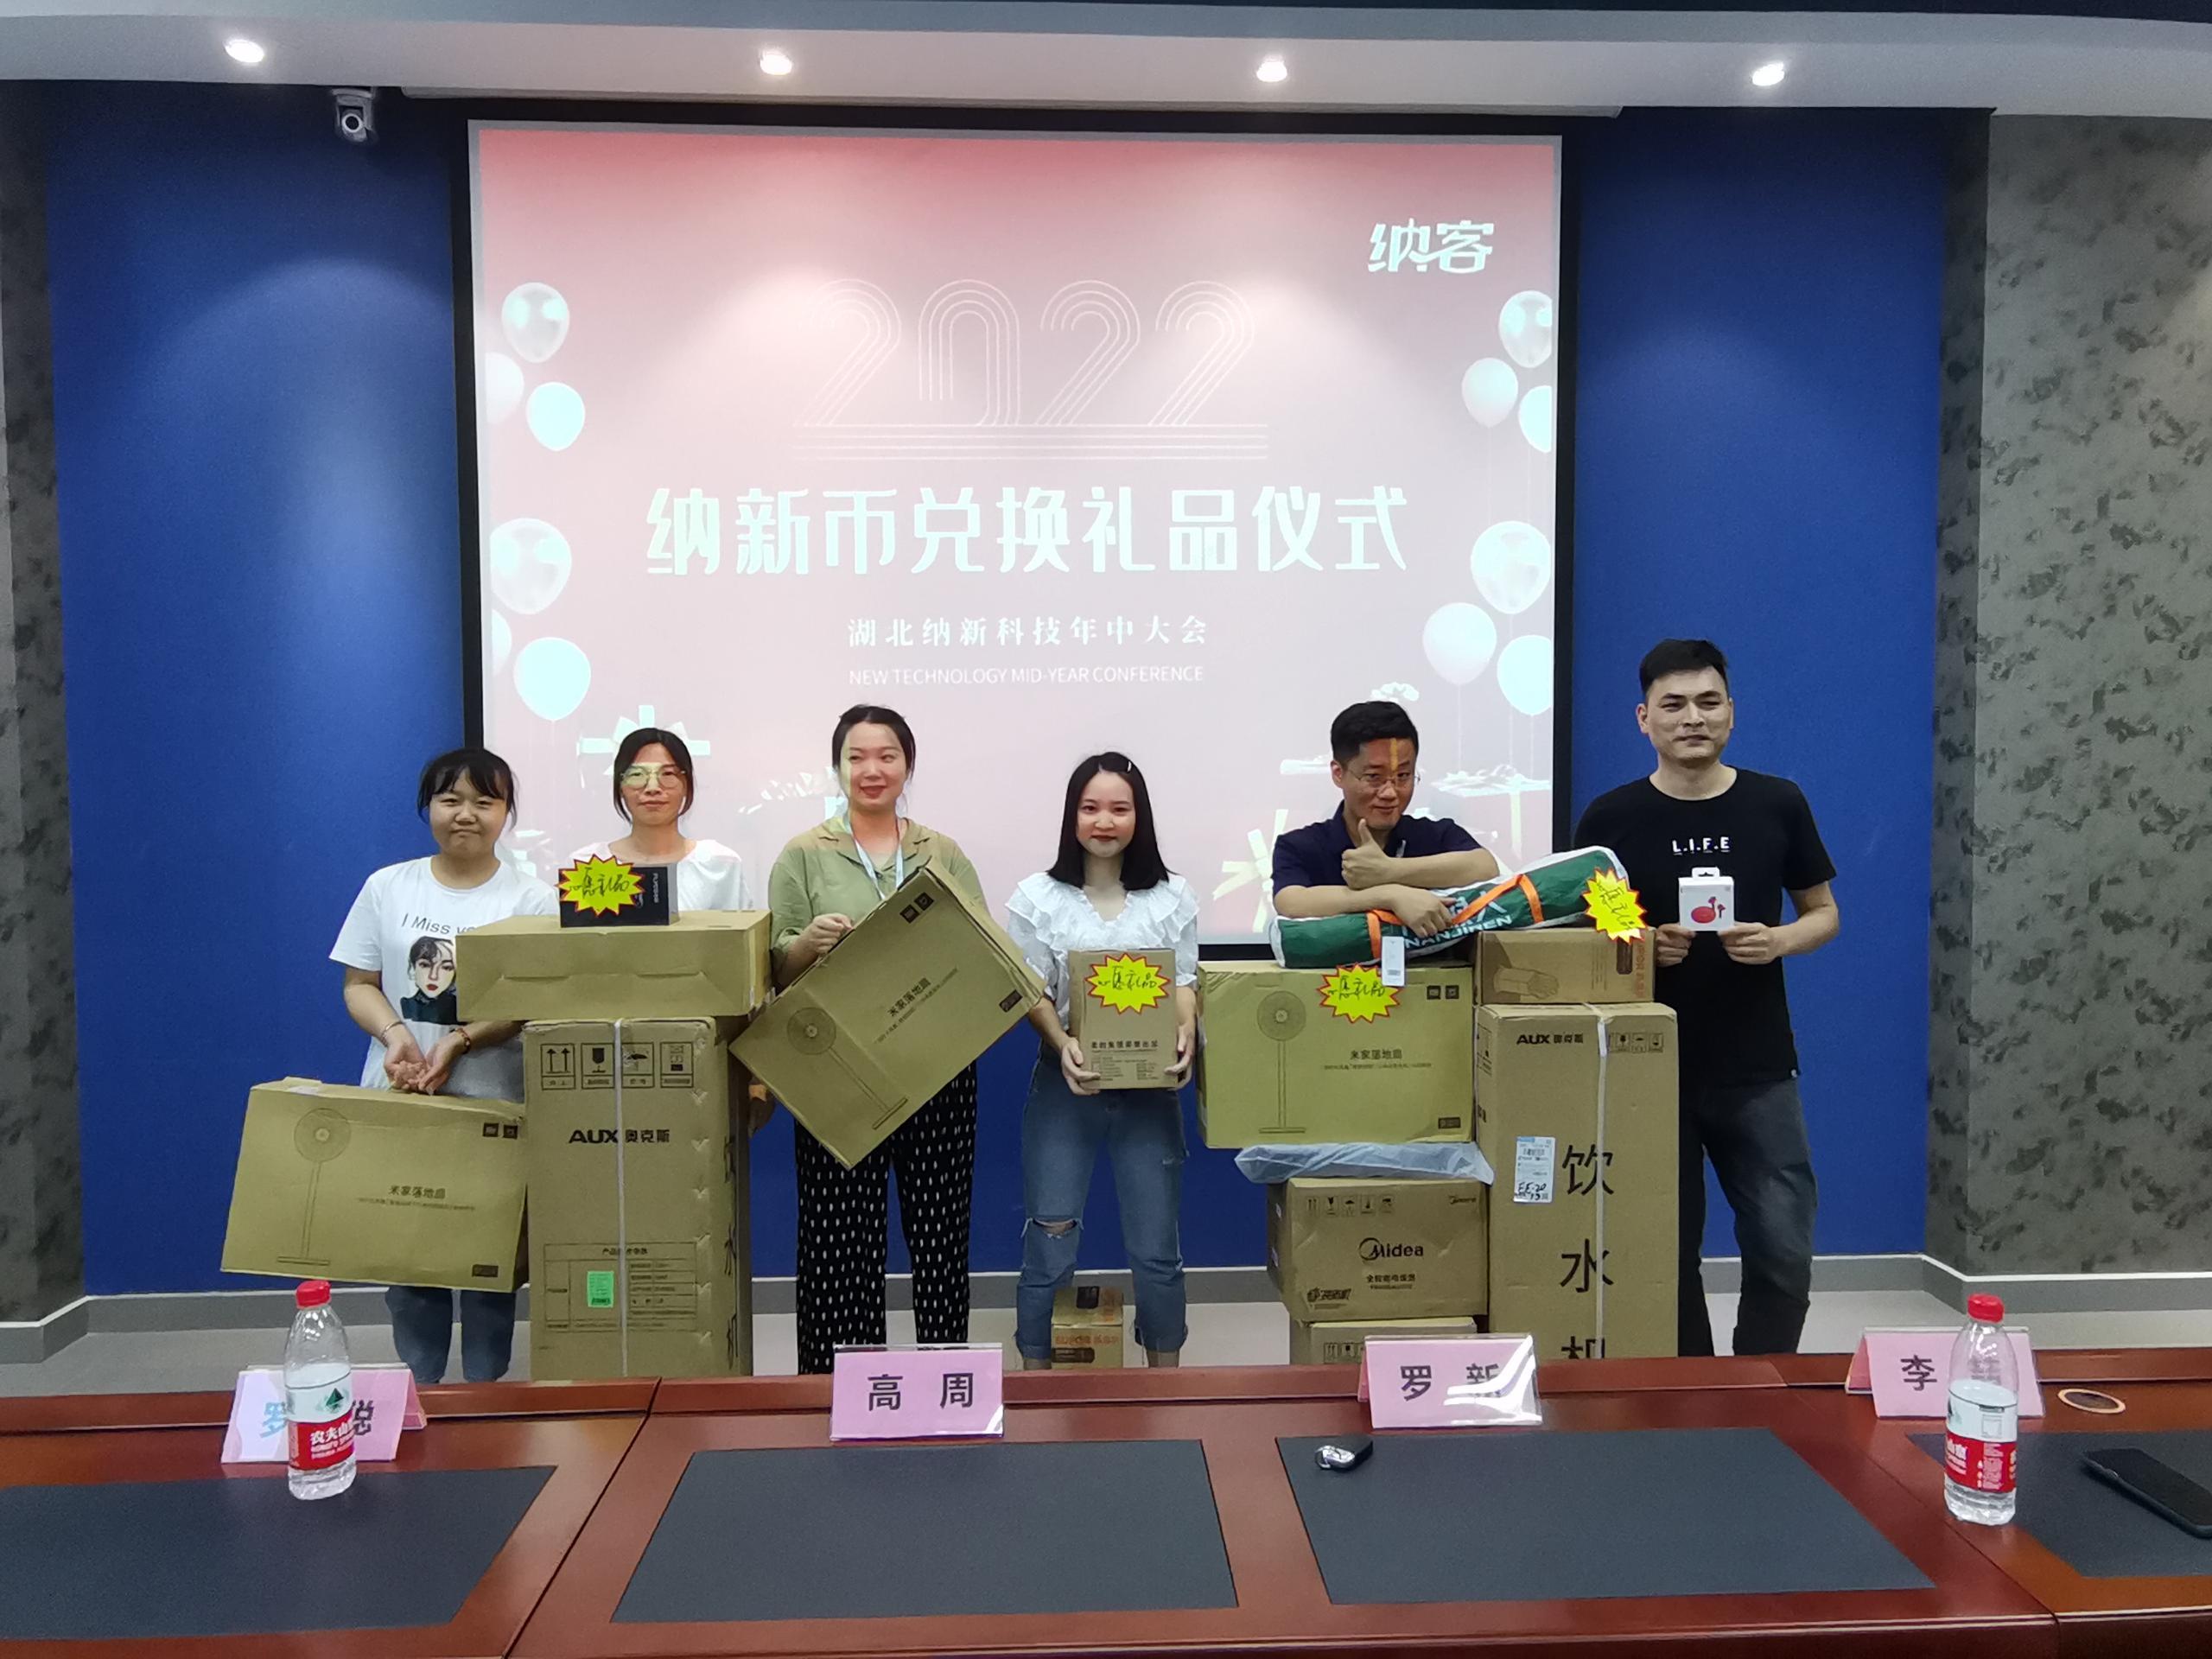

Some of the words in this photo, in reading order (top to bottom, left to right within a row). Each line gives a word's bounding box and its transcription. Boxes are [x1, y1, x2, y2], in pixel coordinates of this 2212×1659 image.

[1368, 219, 1495, 274] 纳客
[793, 278, 1268, 461] 2022
[646, 486, 1408, 576] 纳新币兑换礼品仪式
[848, 615, 1207, 647] 湖北纳新科技年中大会
[849, 670, 889, 685] NEW
[891, 668, 1007, 684] TECHNOLOGY
[1011, 667, 1089, 683] MID-YEAR
[1092, 665, 1204, 683] CONFERENCE
[411, 916, 452, 935] Miss
[1516, 1034, 1550, 1045] AUX
[569, 1129, 619, 1144] AUX
[625, 1129, 671, 1143] 奥克斯
[1358, 1237, 1424, 1262] Midea
[868, 1372, 974, 1412] 高周
